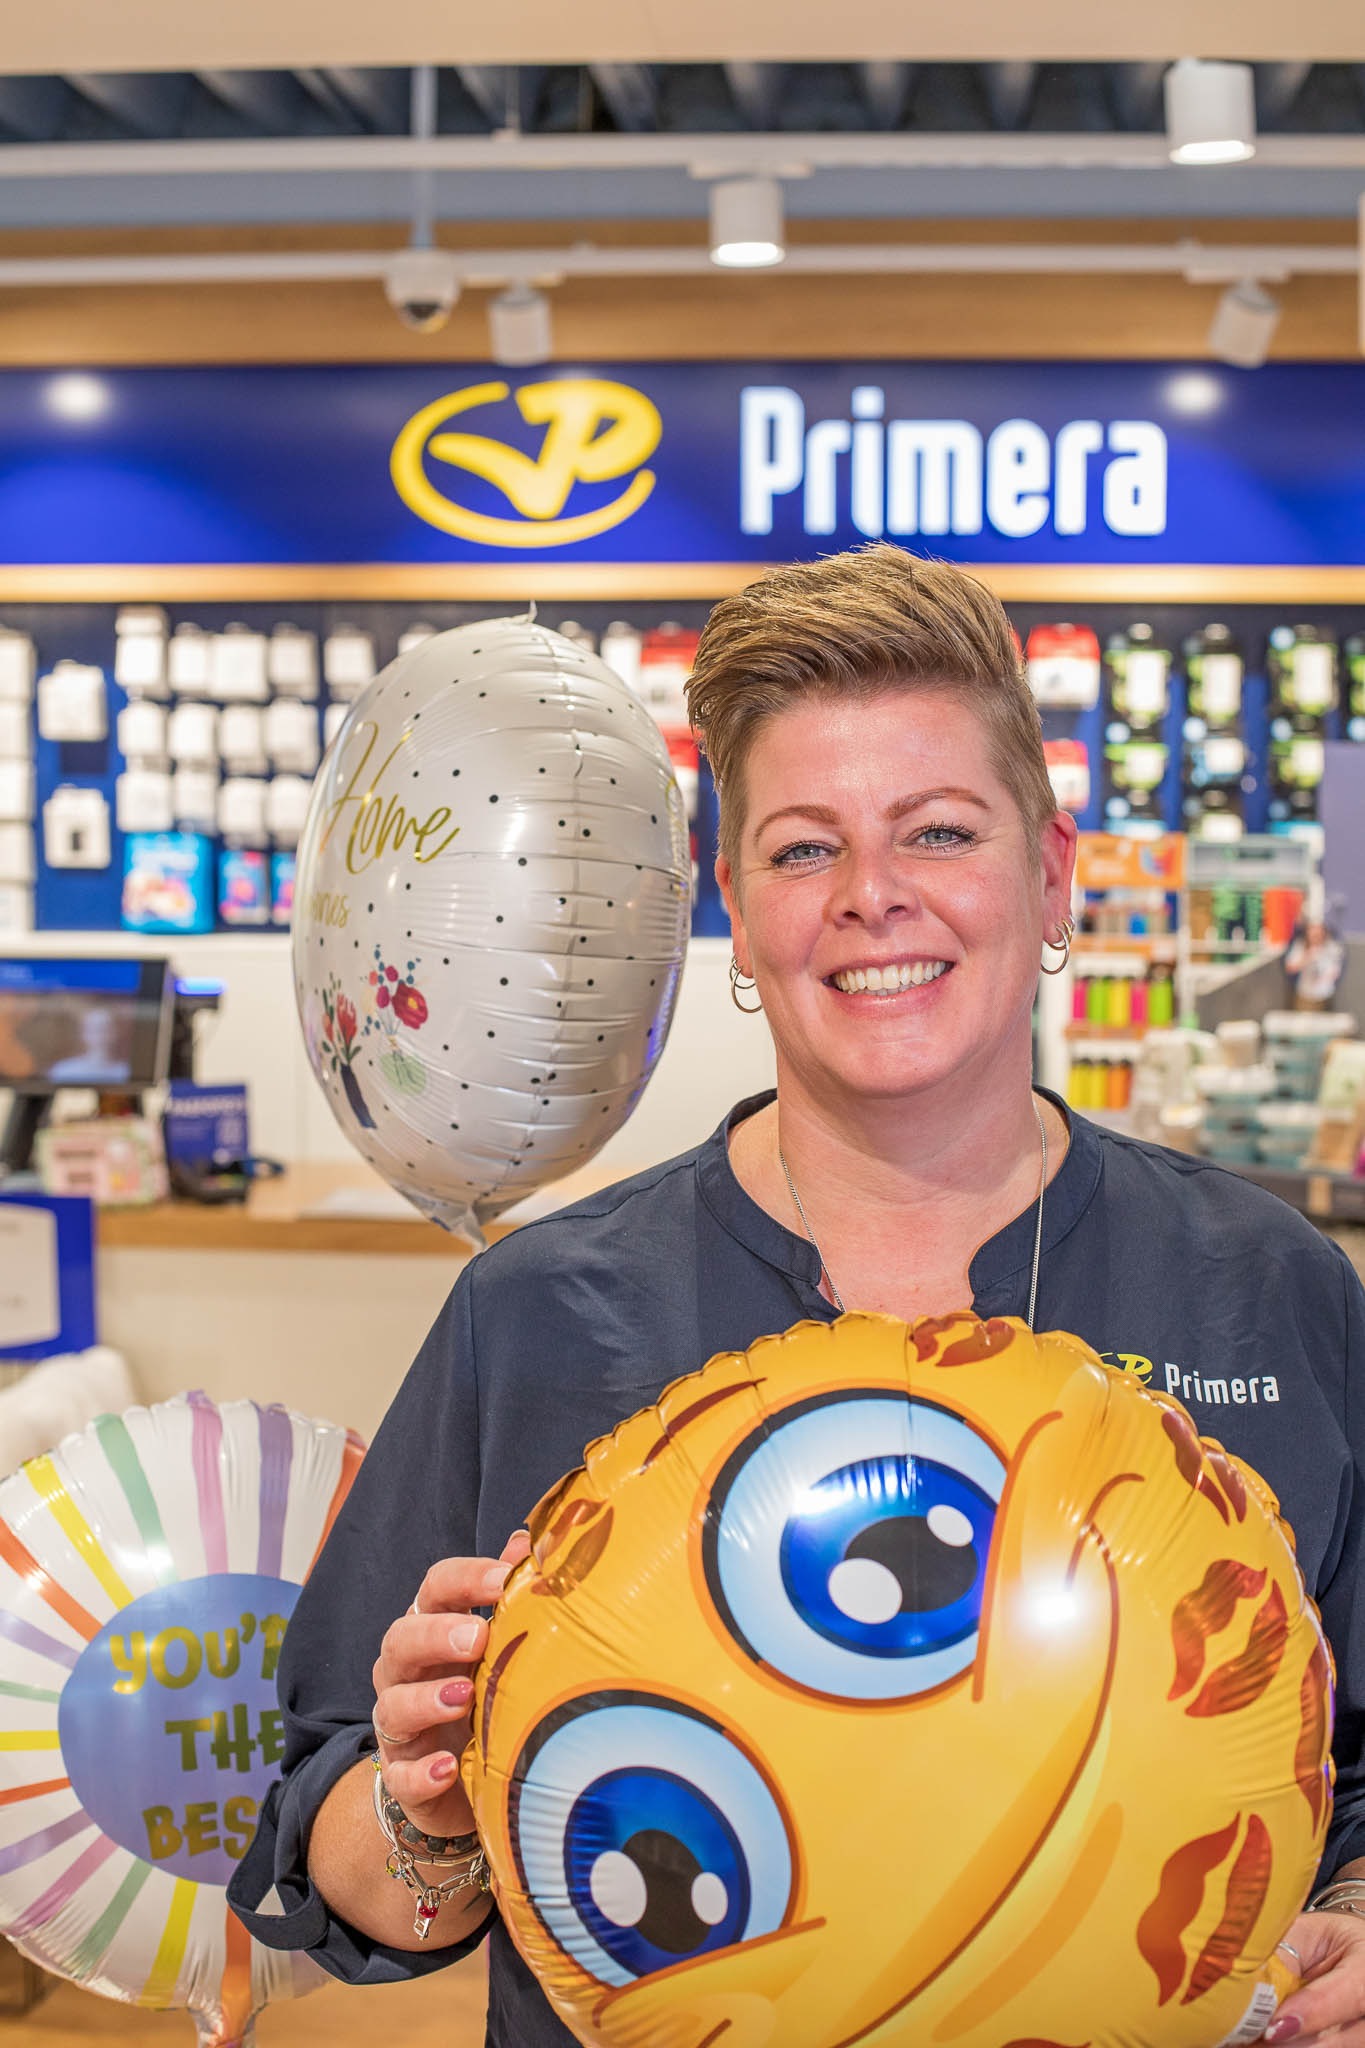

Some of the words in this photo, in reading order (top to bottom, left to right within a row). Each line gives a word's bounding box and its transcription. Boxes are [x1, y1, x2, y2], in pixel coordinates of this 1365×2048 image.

[739, 385, 1168, 537] Primera
[319, 721, 460, 874] Home
[1164, 1362, 1280, 1405] Primera
[165, 1703, 287, 1773] THE
[142, 1795, 263, 1861] BES
